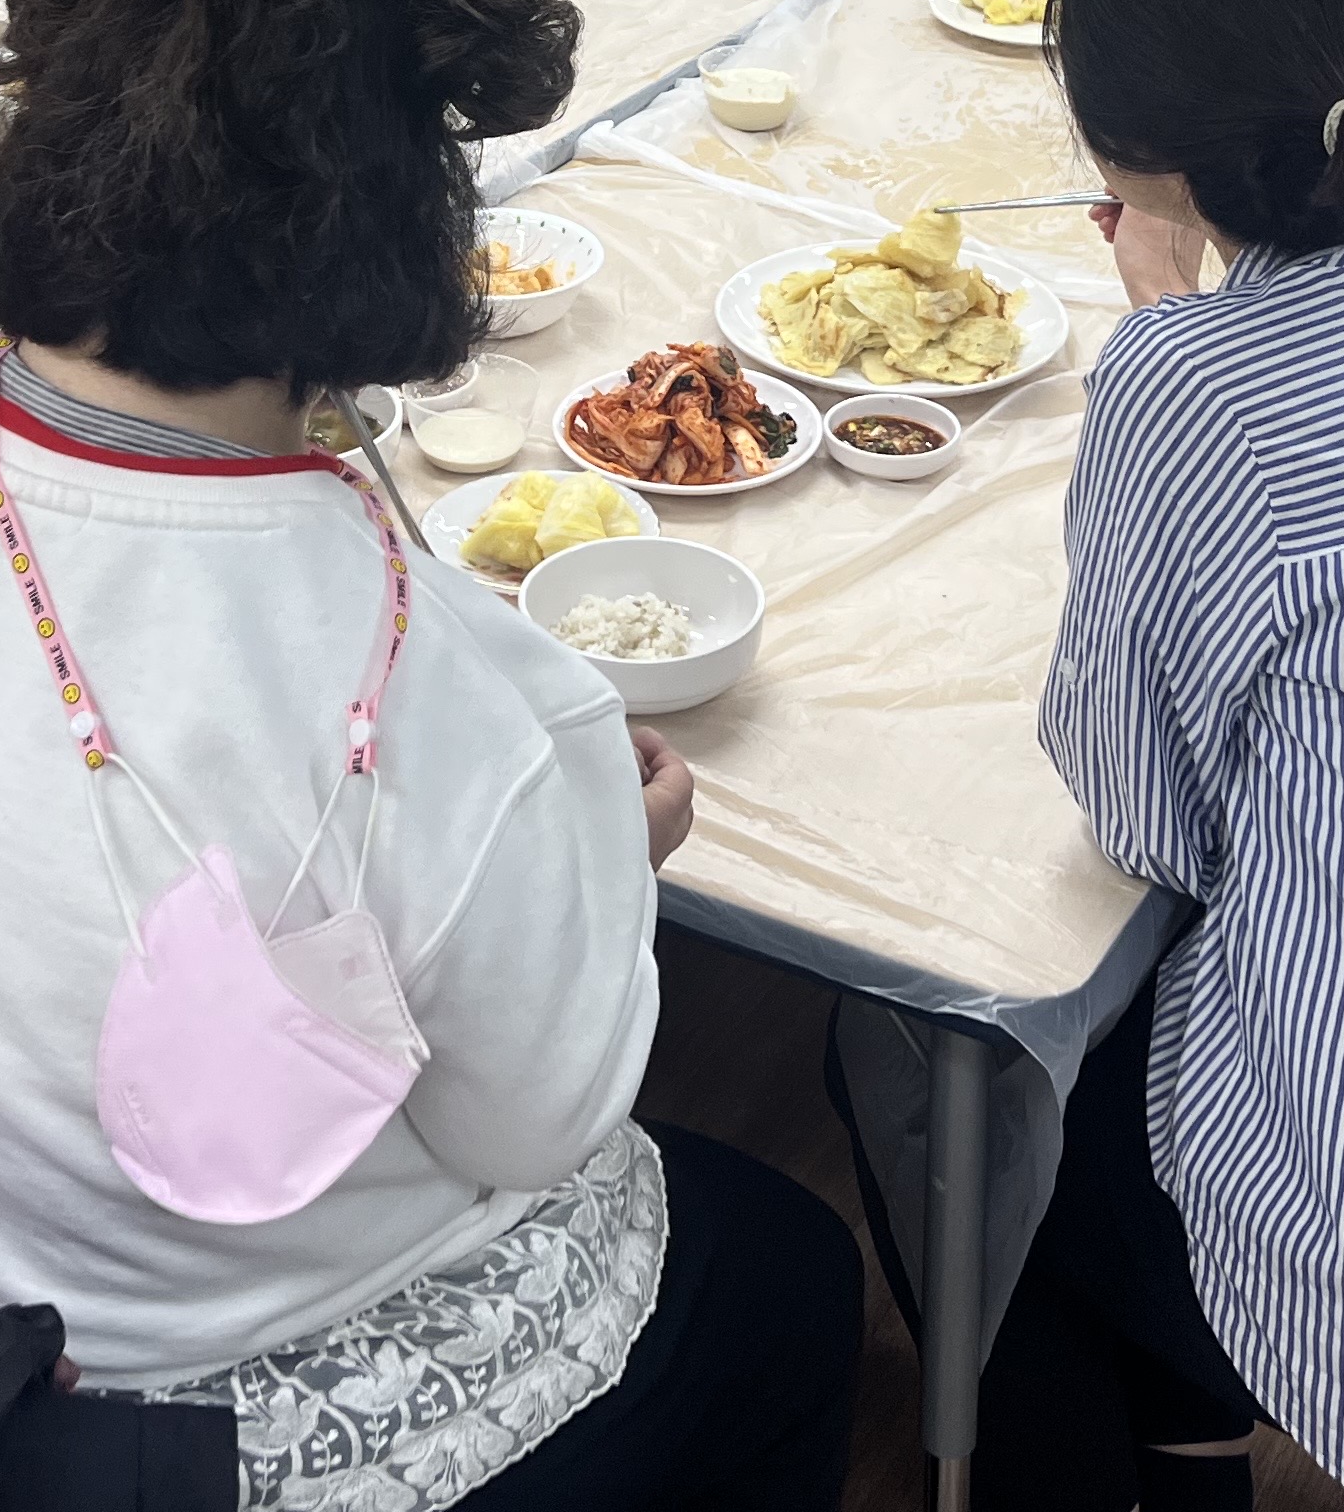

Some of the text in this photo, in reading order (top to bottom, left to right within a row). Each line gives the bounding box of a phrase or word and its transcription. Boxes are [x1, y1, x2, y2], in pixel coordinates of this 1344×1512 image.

[0, 513, 19, 551] SMILE
[24, 577, 45, 616] SMILE
[396, 575, 406, 608] SMILE
[49, 642, 71, 681] SMILE
